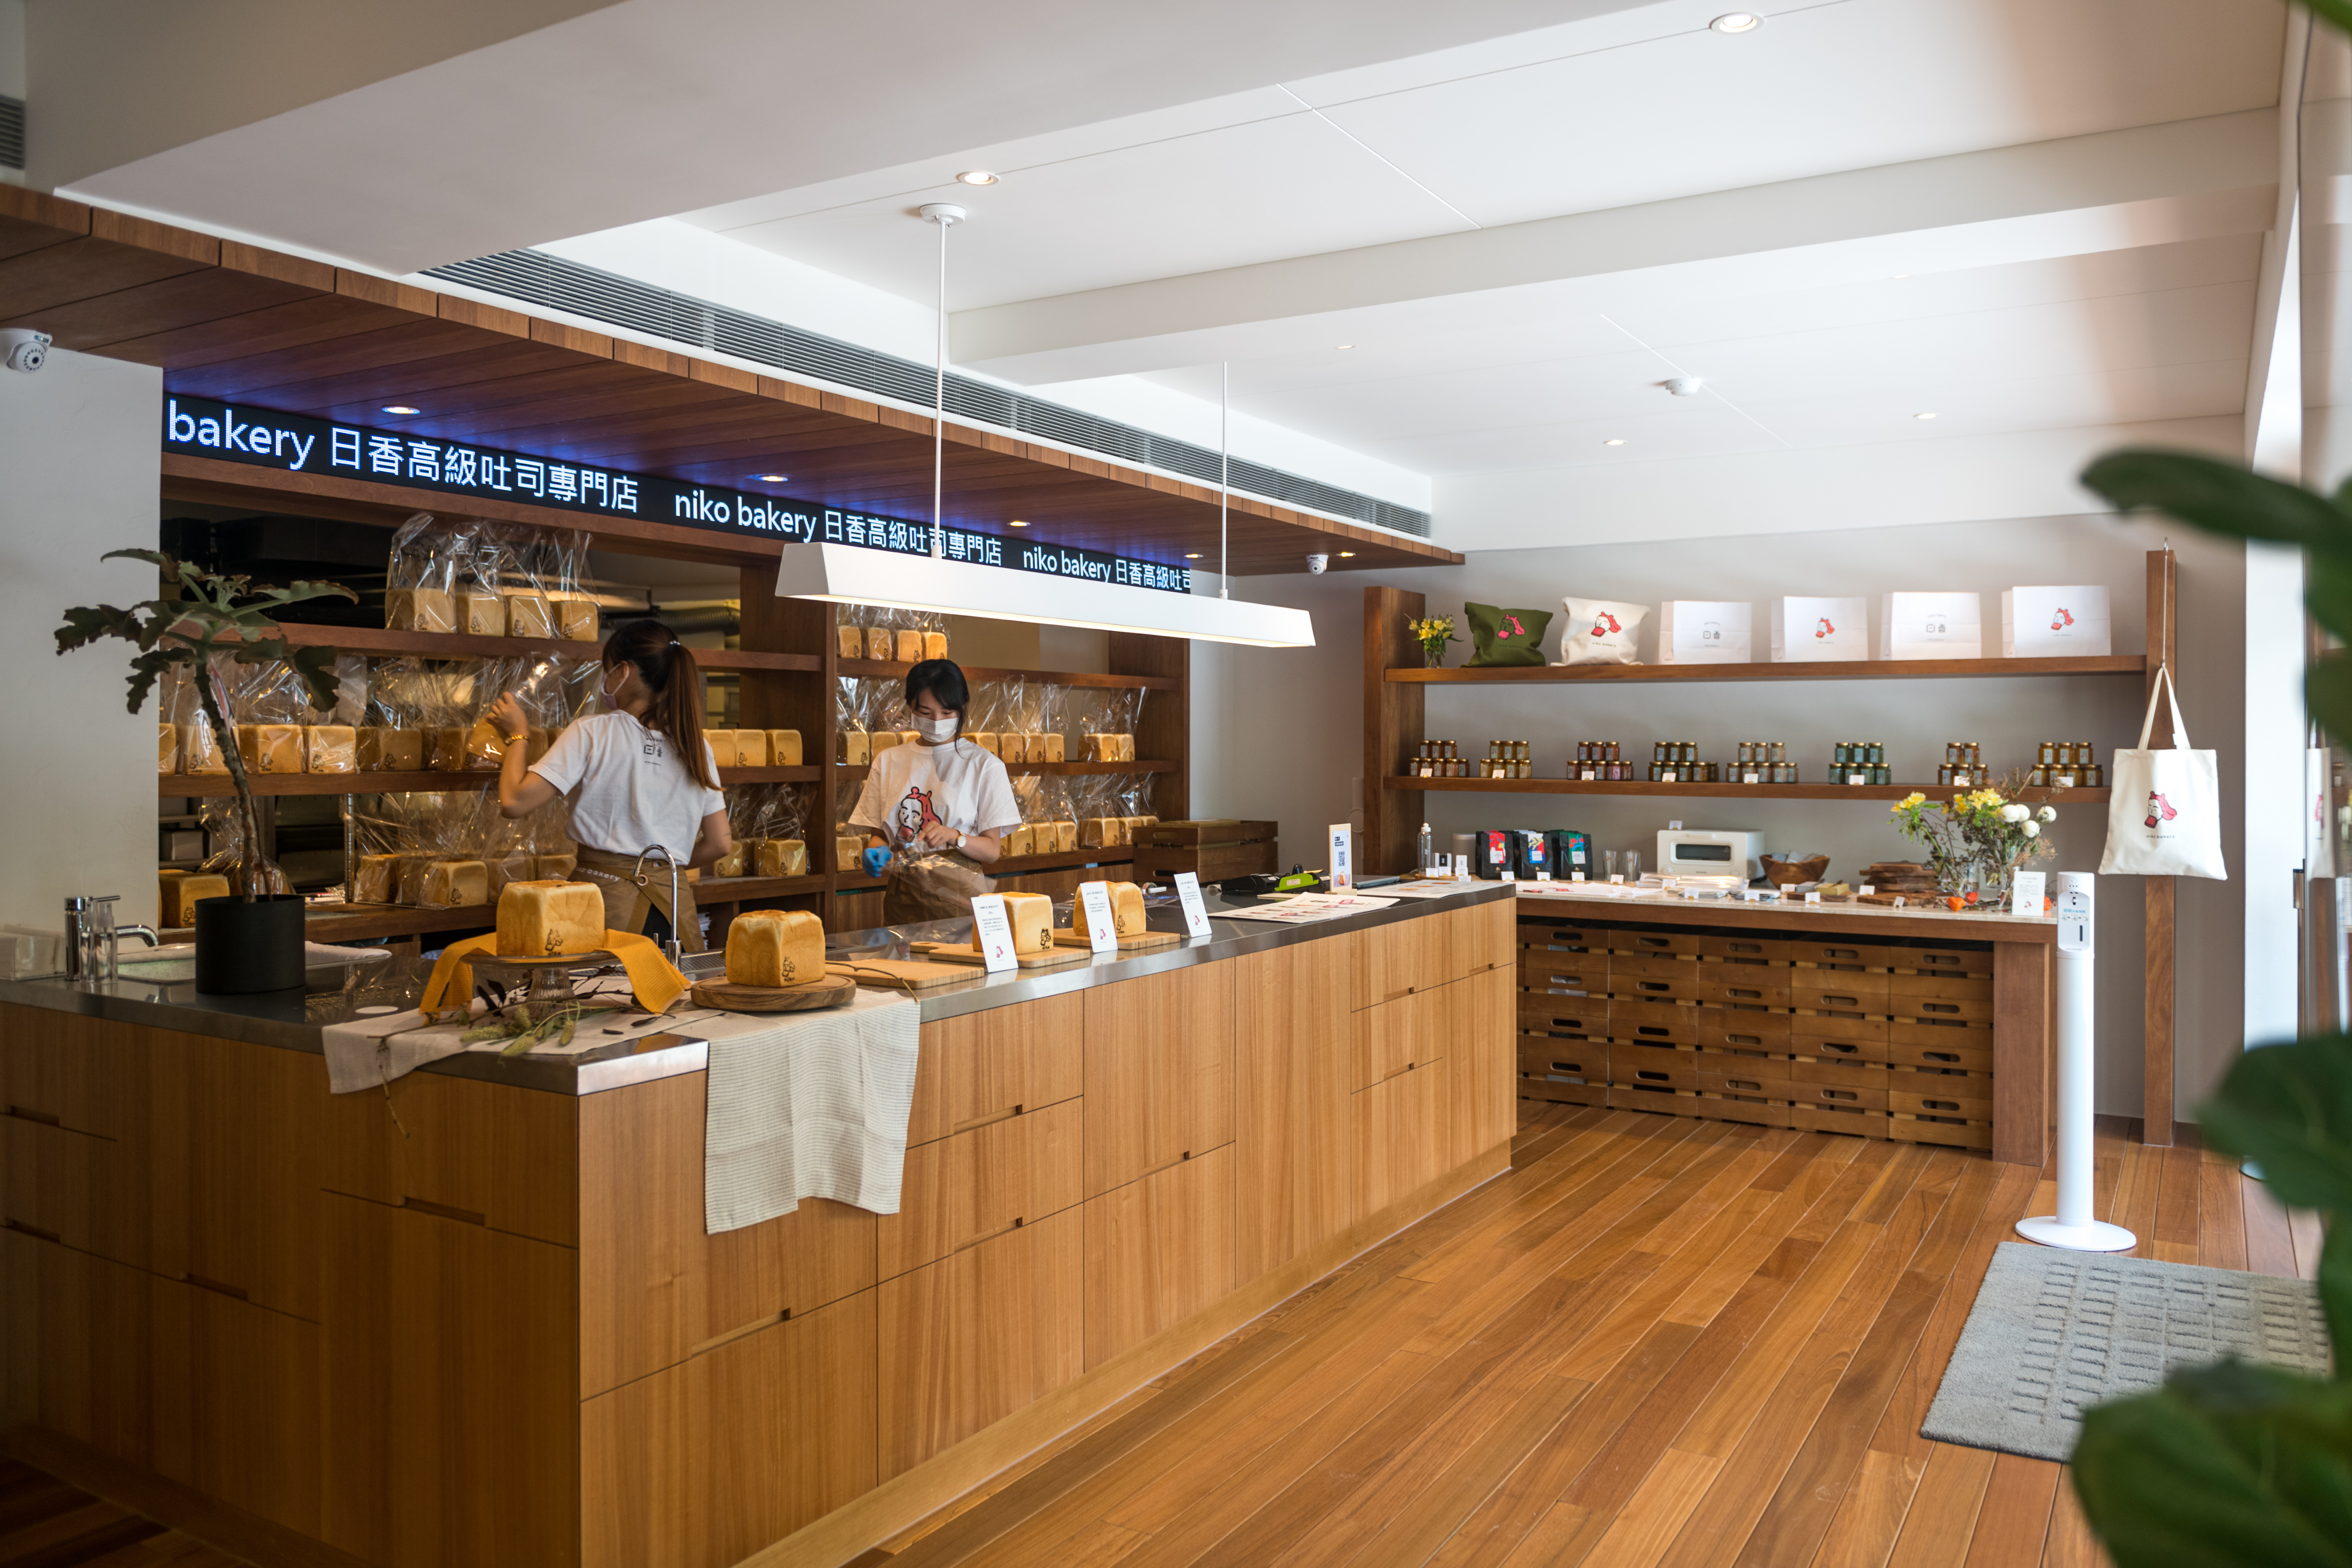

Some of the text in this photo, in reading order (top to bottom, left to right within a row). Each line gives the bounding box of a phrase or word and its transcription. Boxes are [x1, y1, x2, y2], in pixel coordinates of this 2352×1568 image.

[169, 398, 315, 470] bakery
[332, 426, 638, 514] 日香高級吐司專門店
[675, 489, 730, 523] niko
[737, 495, 817, 543] bakery
[825, 510, 1002, 566] 日香高級吐司專門店
[1023, 546, 1057, 572] niko
[1061, 550, 1111, 583] bakery
[587, 869, 620, 882] bakery
